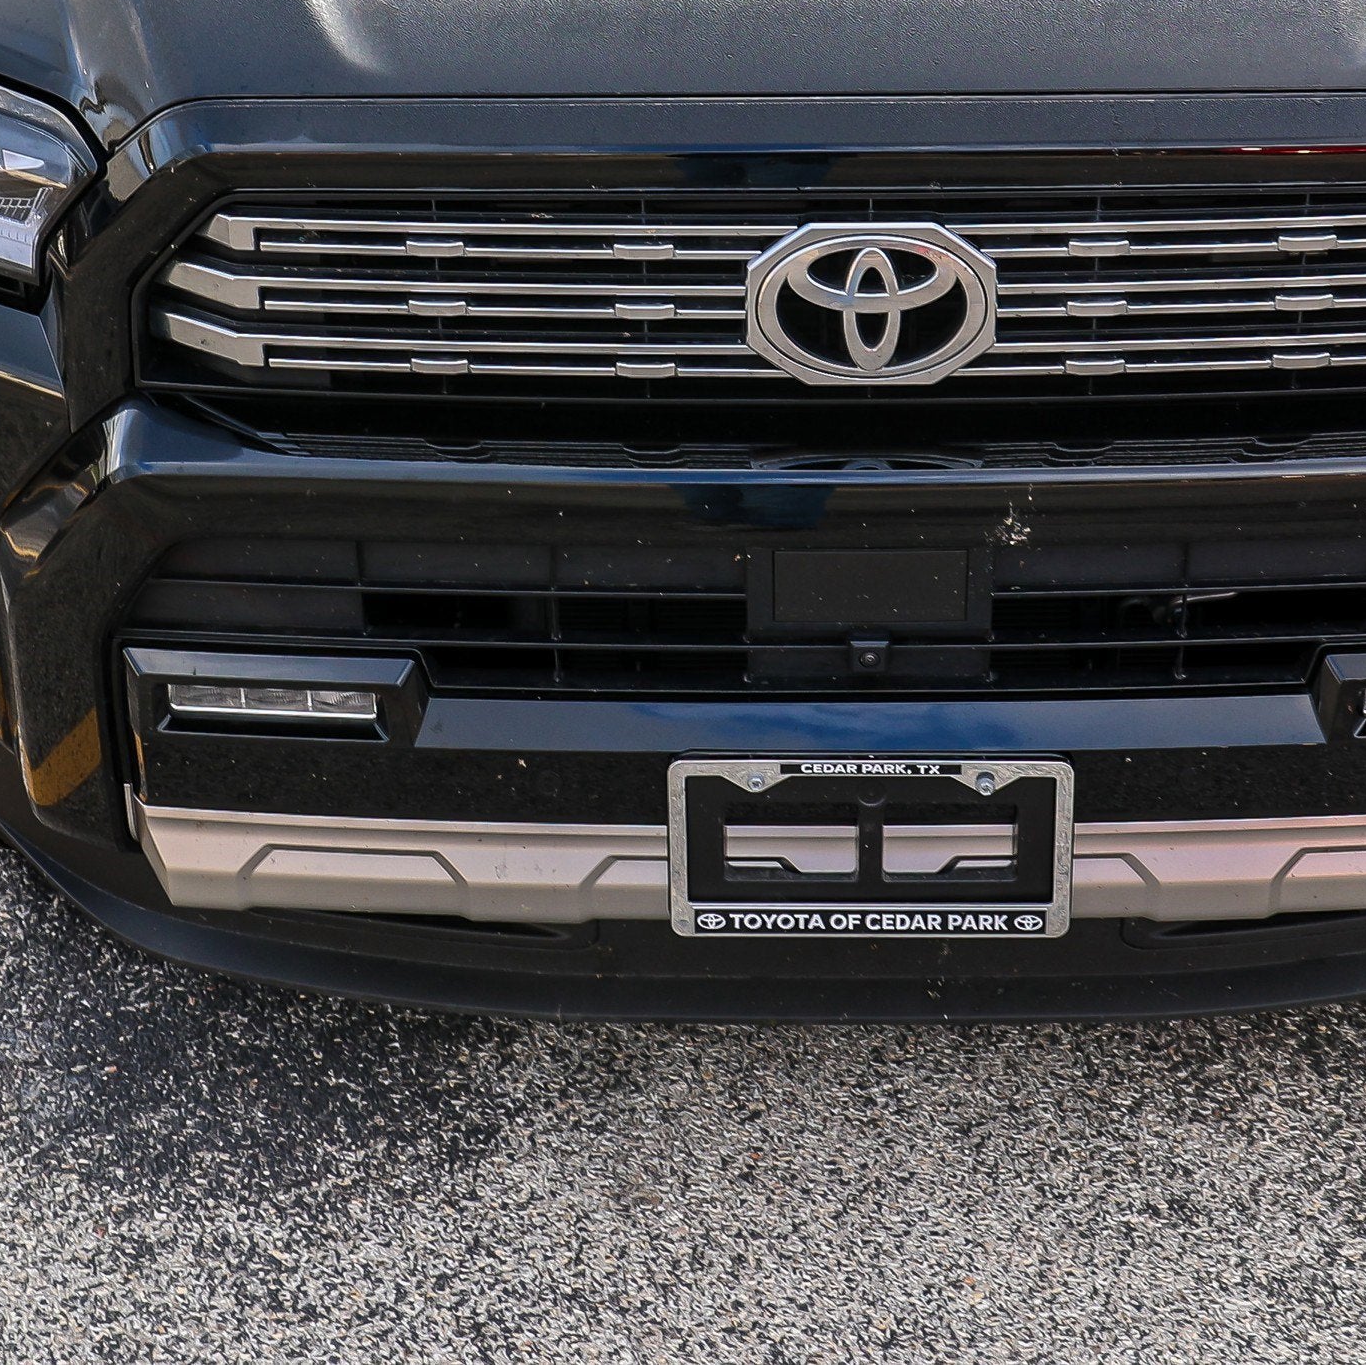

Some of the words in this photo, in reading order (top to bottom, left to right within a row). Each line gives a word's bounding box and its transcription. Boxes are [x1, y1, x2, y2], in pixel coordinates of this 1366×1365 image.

[800, 762, 858, 774] CEDAR
[916, 764, 941, 775] TX
[729, 913, 826, 931] TOYOTA
[829, 913, 863, 931] OF
[864, 914, 943, 931] CEDAR
[947, 914, 1009, 931] PARK
